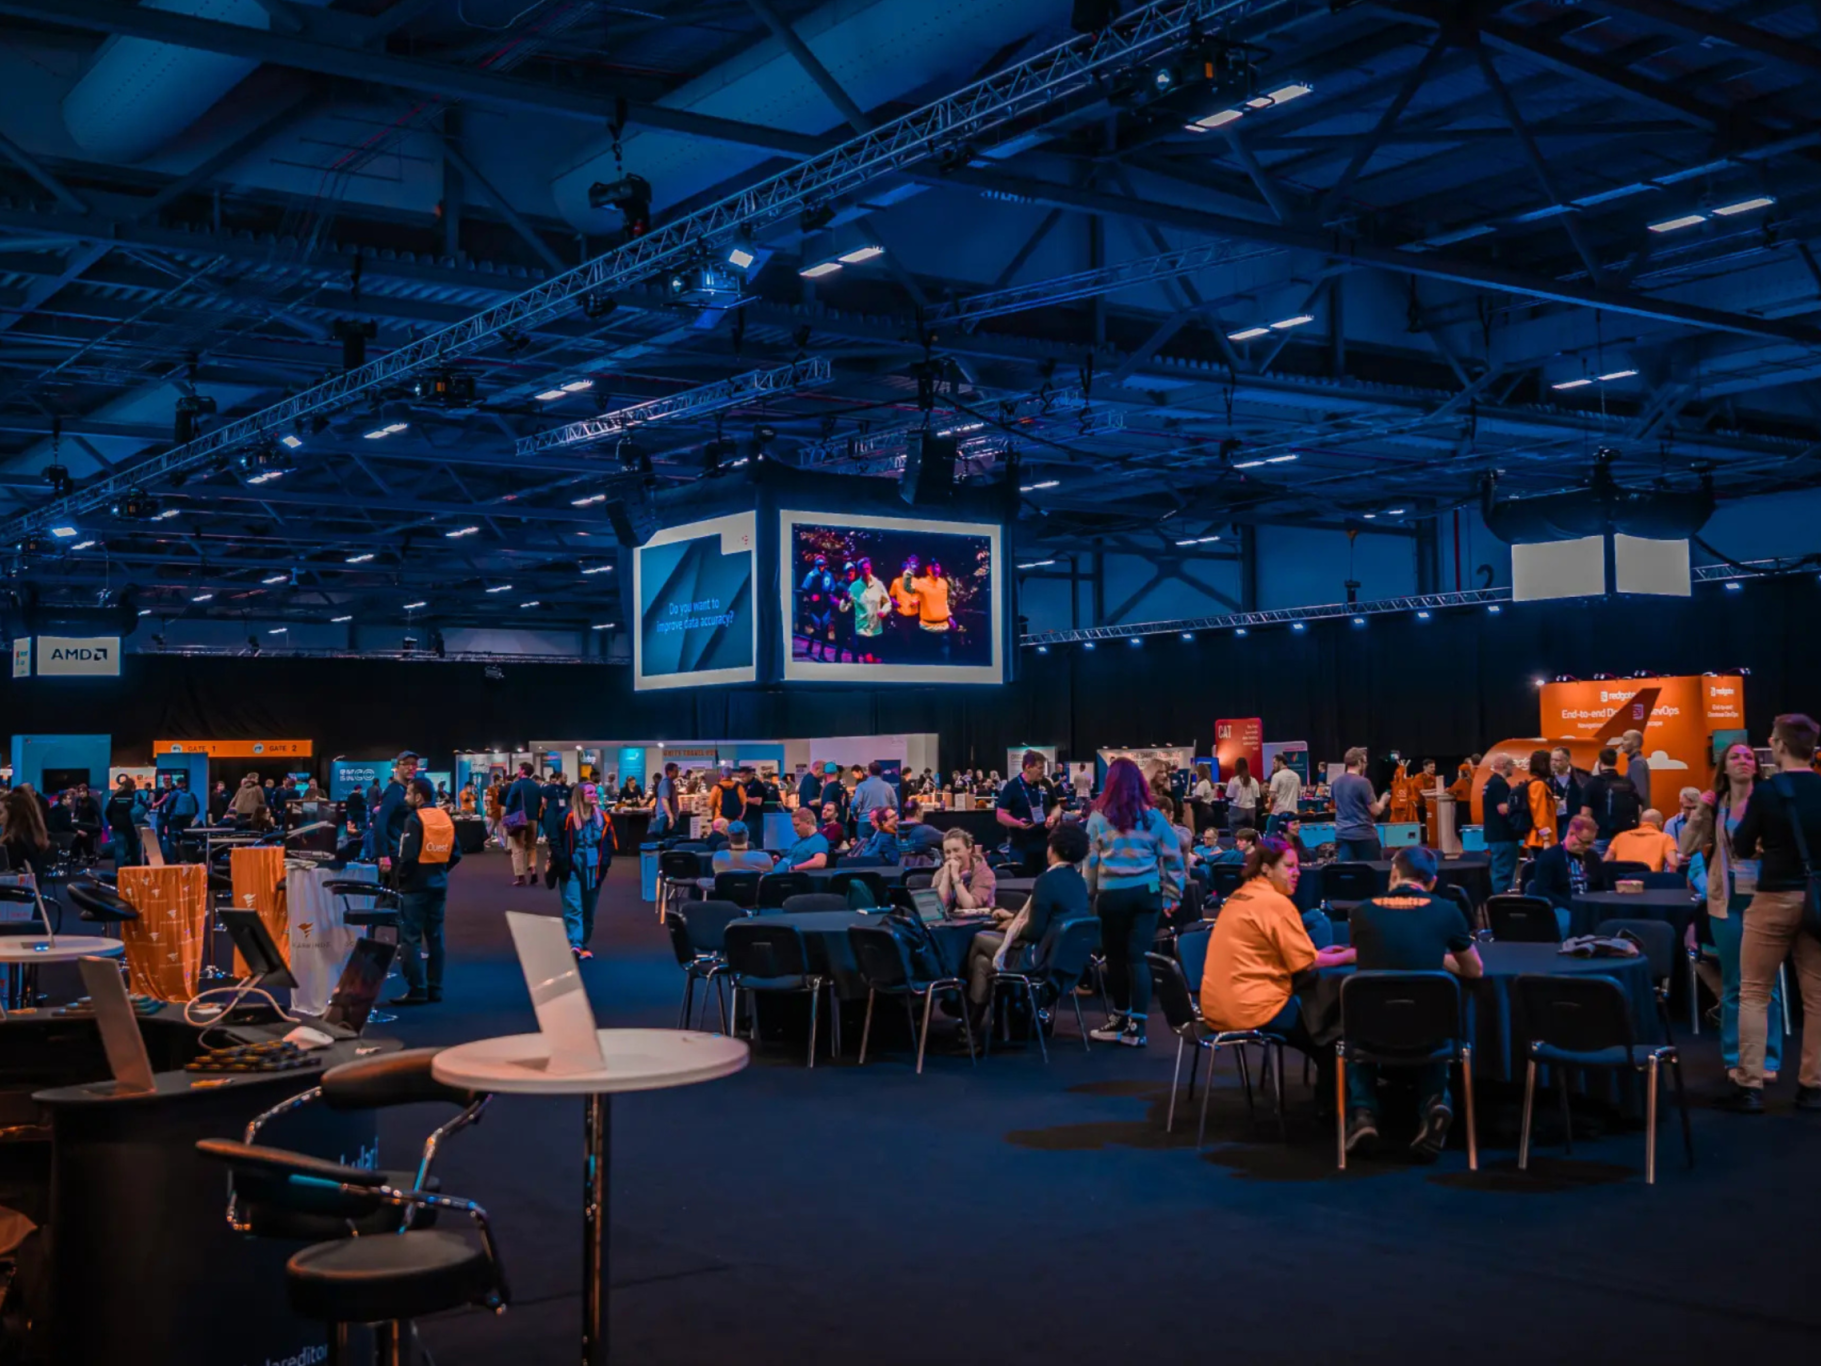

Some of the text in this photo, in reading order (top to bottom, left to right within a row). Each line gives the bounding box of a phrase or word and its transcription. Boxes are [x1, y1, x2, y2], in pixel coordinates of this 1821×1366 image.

[669, 597, 720, 616] Do you want to
[656, 610, 734, 635] improve data accuracy?
[50, 648, 93, 661] AMD
[1561, 708, 1606, 719] End-to-end
[1651, 705, 1680, 717] evOps
[1218, 724, 1232, 739] CAT
[187, 745, 217, 753] GATE 1
[291, 744, 298, 752] 2
